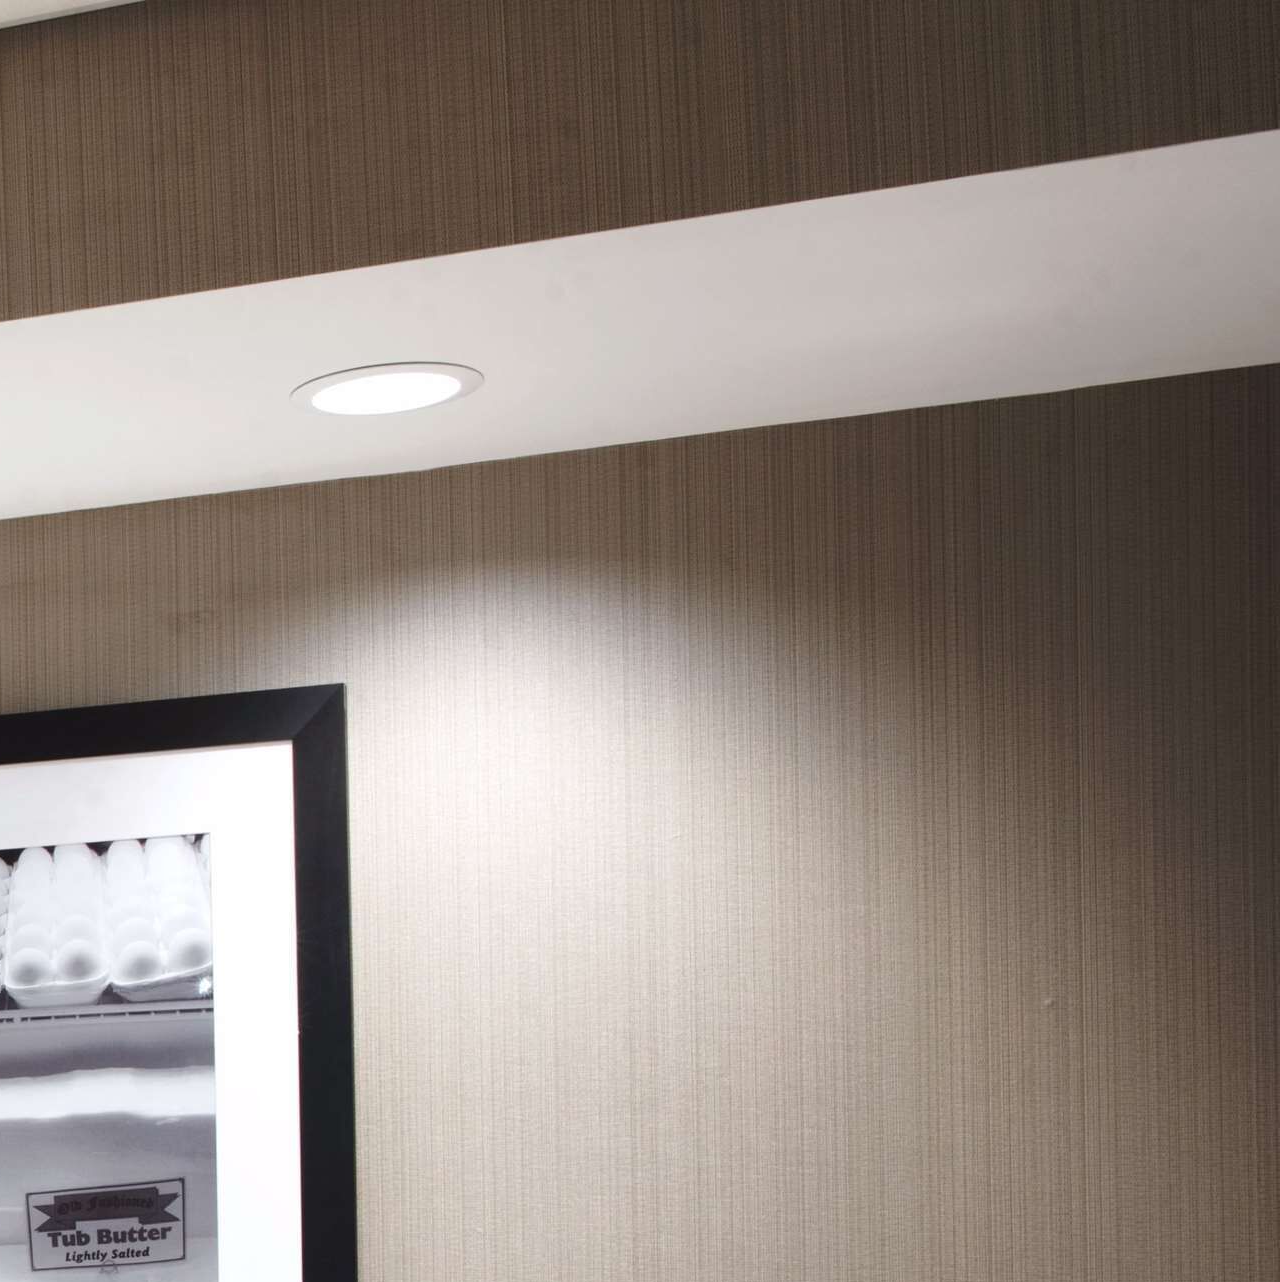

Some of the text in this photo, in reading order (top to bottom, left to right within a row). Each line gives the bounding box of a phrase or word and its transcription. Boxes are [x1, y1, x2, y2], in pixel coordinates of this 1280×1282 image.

[47, 1226, 172, 1248] Tub Butter
[65, 1246, 151, 1264] Lightly Salted
